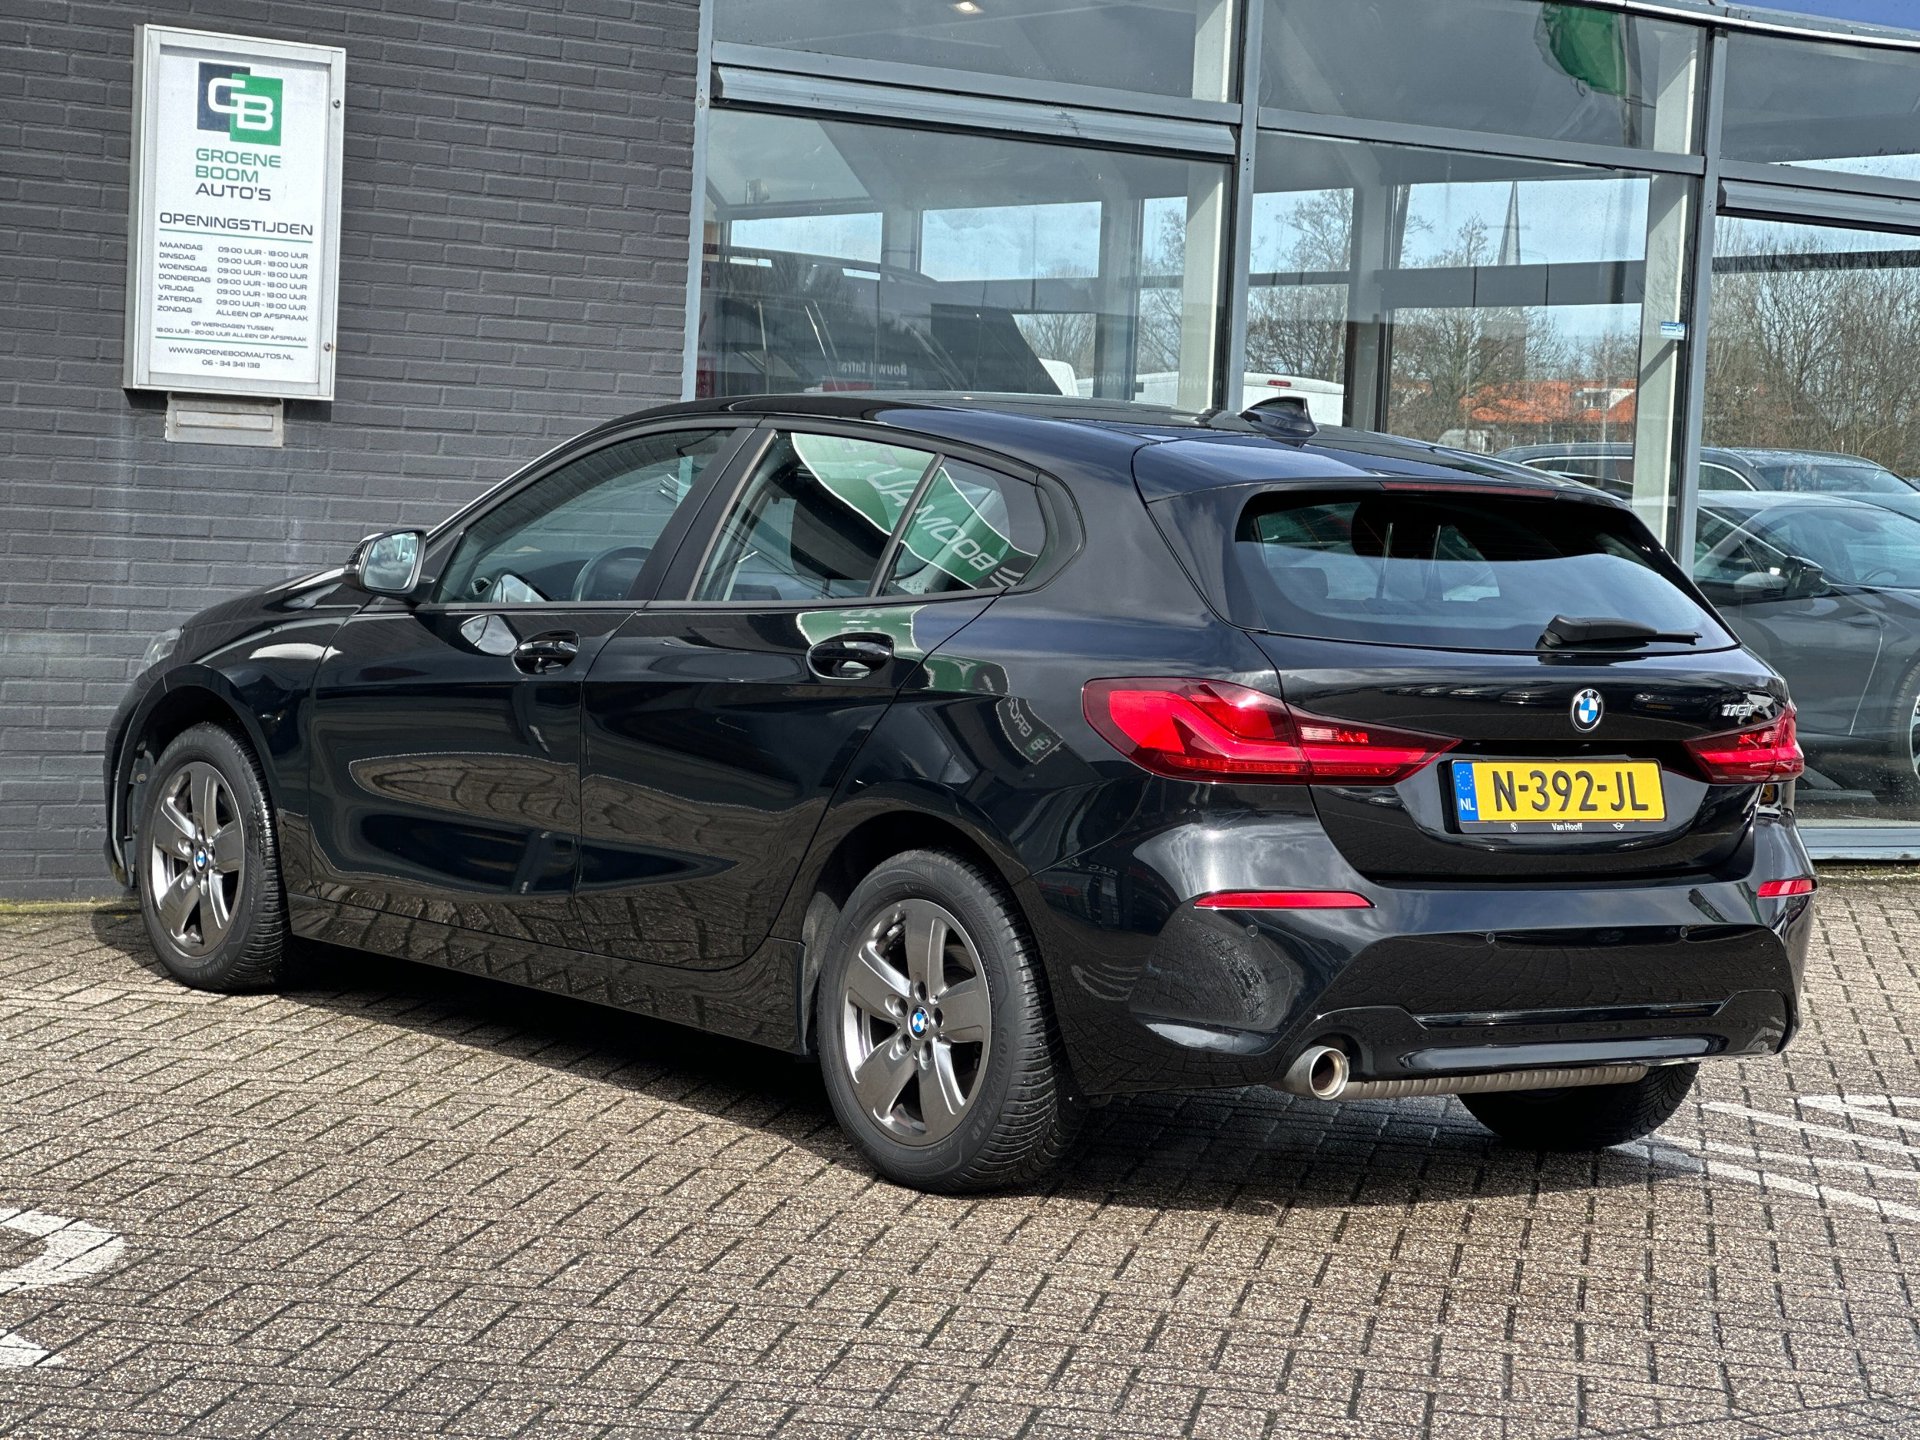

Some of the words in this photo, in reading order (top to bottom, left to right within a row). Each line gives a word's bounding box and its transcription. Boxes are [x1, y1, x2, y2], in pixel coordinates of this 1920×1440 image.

[196, 148, 281, 168] GROENE
[195, 165, 259, 183] BOOM
[195, 183, 271, 201] AUTO'S
[159, 212, 313, 235] OPENINGSTIJDEN
[159, 242, 203, 251] MAANDAG
[244, 248, 262, 256] UUR
[159, 252, 196, 260] DINSDAG
[159, 262, 208, 272] WOENSDAG
[158, 273, 211, 283] DONDERDAG
[158, 284, 194, 292] VRIJDAG
[242, 290, 260, 298] UUR
[158, 294, 202, 304] ZATERDAG
[157, 305, 192, 313] ZONDAG
[264, 312, 308, 321] AFSPRAAK
[1491, 769, 1650, 812] N-392-JL
[1460, 798, 1476, 811] NL
[1552, 823, 1564, 831] Van
[1565, 822, 1583, 832] Hooff
